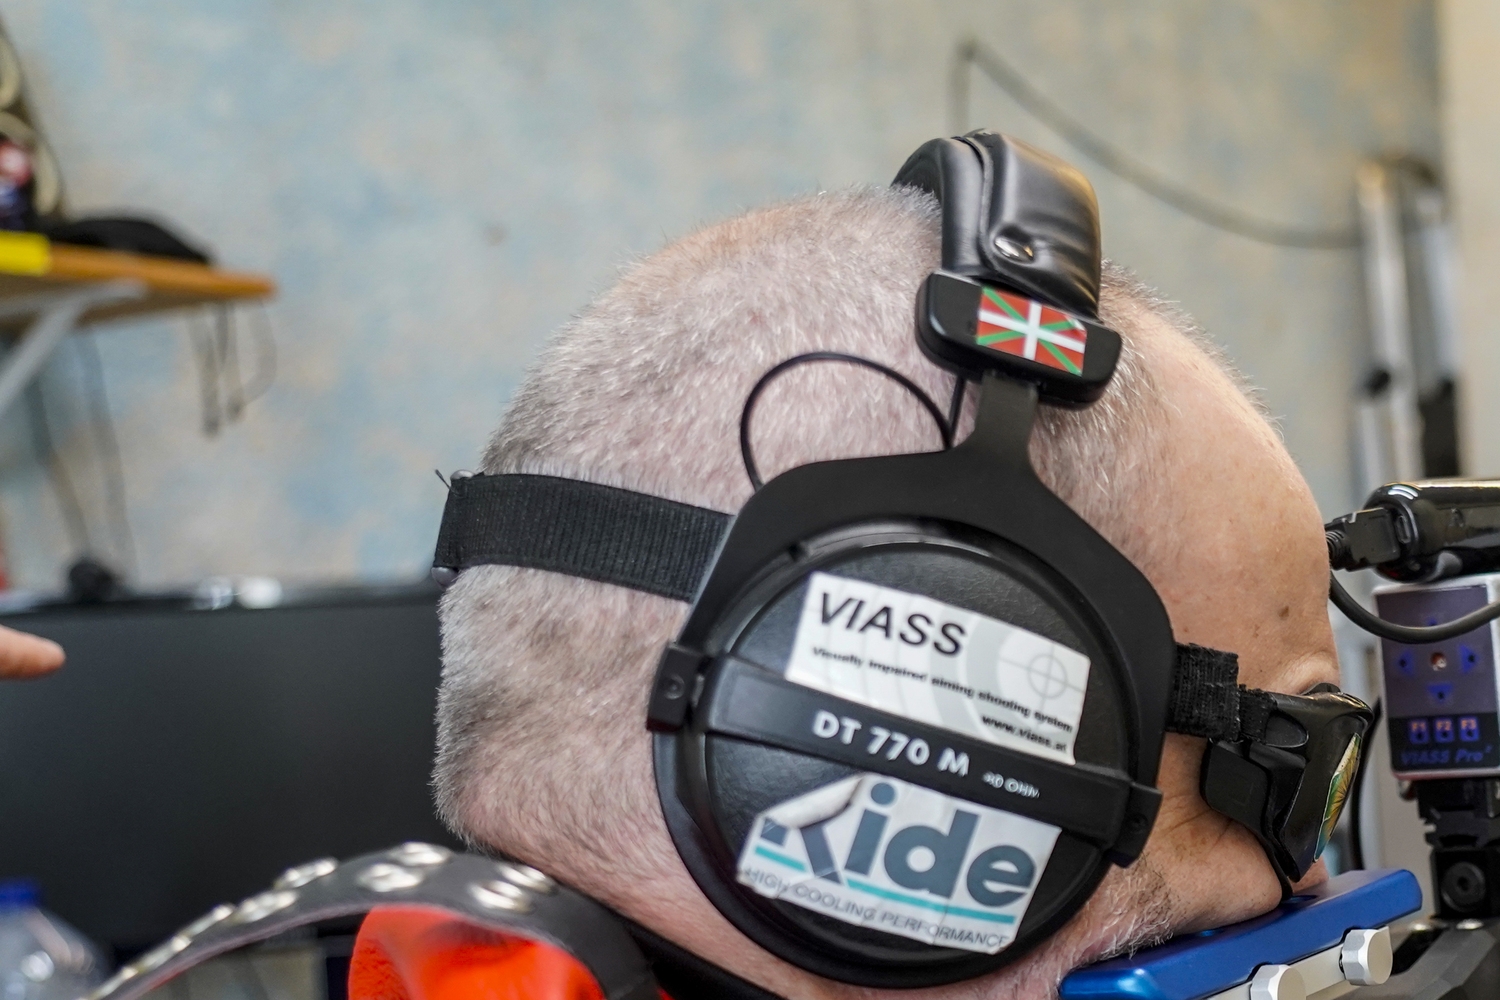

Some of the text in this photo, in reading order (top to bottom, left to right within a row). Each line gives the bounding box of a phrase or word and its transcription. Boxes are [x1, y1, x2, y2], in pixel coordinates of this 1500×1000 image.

[821, 592, 967, 656] VIASS
[869, 659, 928, 682] impaired
[931, 676, 975, 698] aiming
[978, 691, 1031, 718] shooting
[1033, 711, 1073, 733] system
[812, 709, 862, 745] DT
[867, 725, 931, 765] 770
[936, 747, 970, 777] M
[794, 886, 877, 922] COOLING
